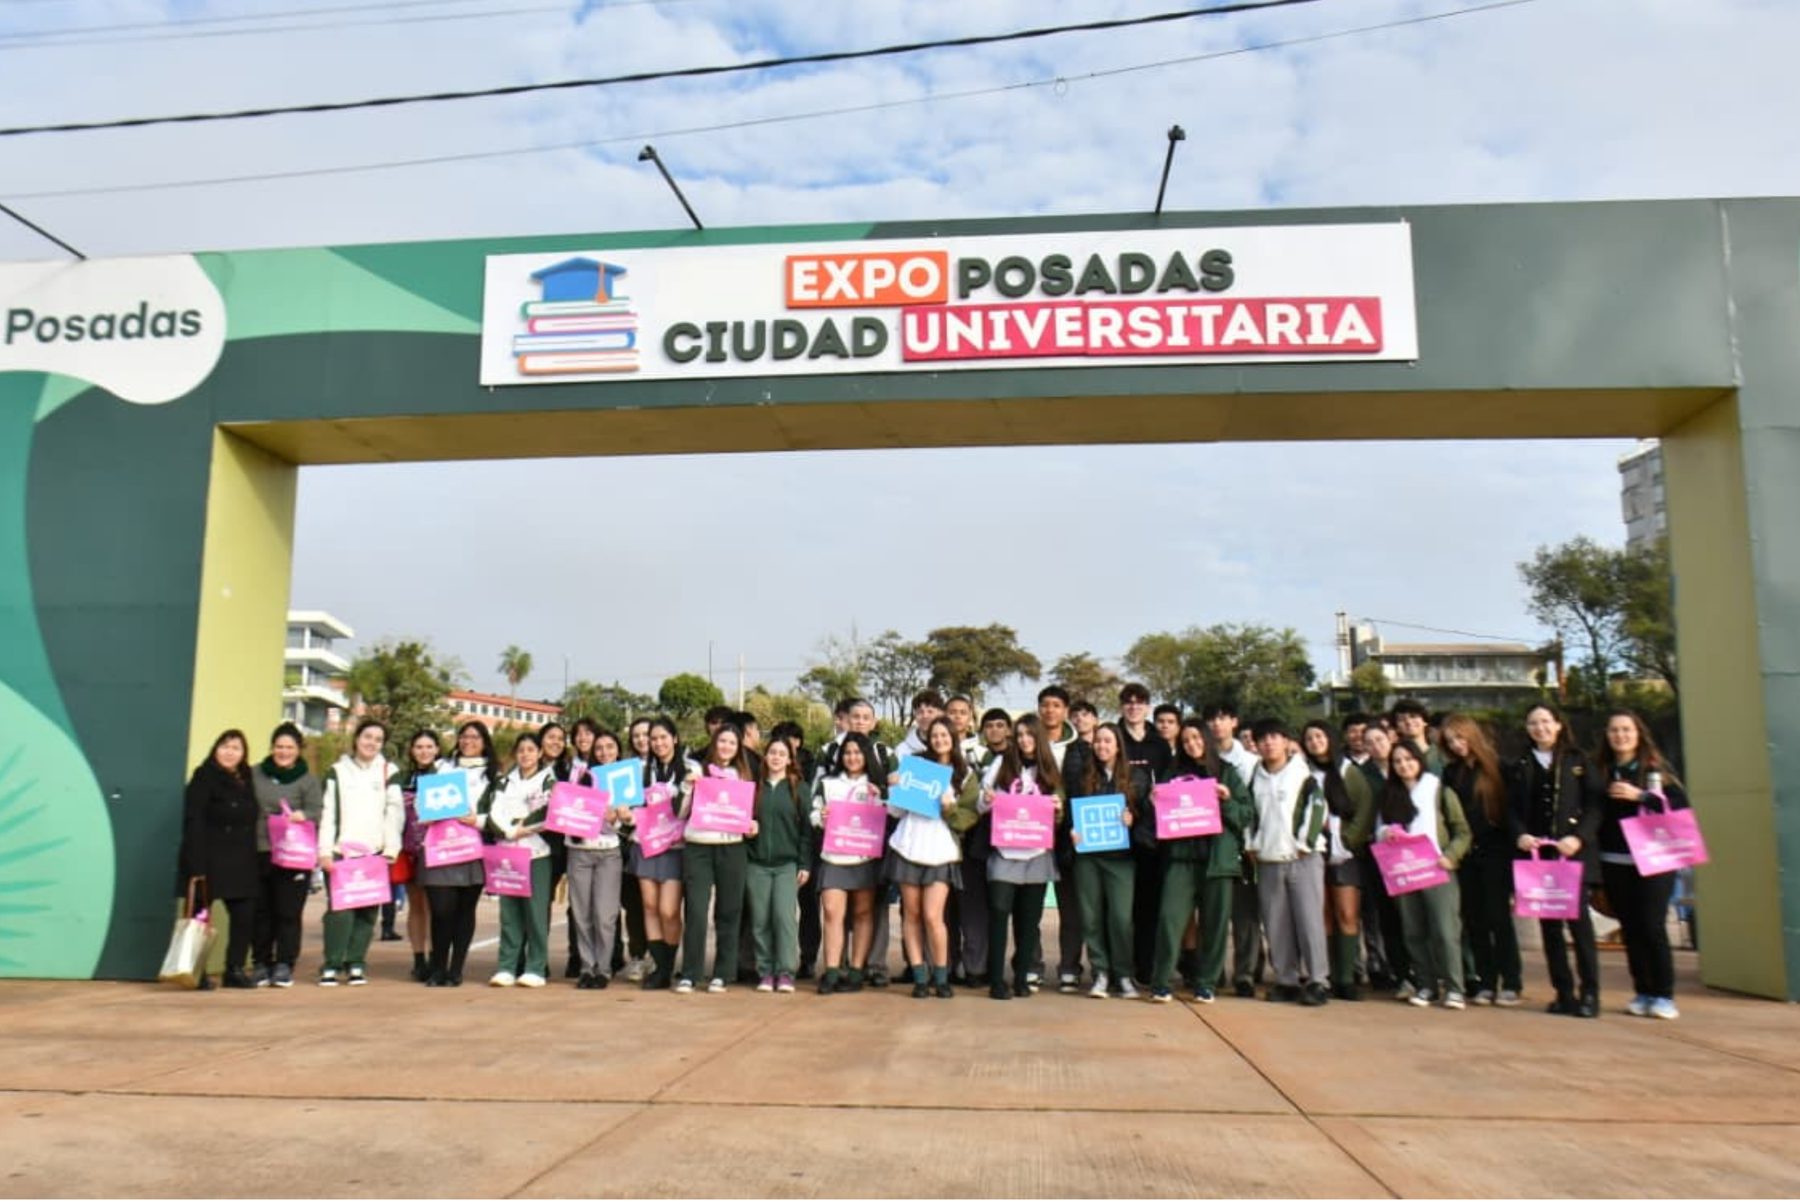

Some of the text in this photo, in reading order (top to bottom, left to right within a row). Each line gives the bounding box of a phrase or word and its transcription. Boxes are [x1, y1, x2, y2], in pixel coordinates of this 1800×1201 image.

[792, 249, 1236, 301] EXPO POSADAS
[5, 301, 203, 345] Posadas
[662, 303, 1376, 363] CIUDAD UNIVERSITARIA
